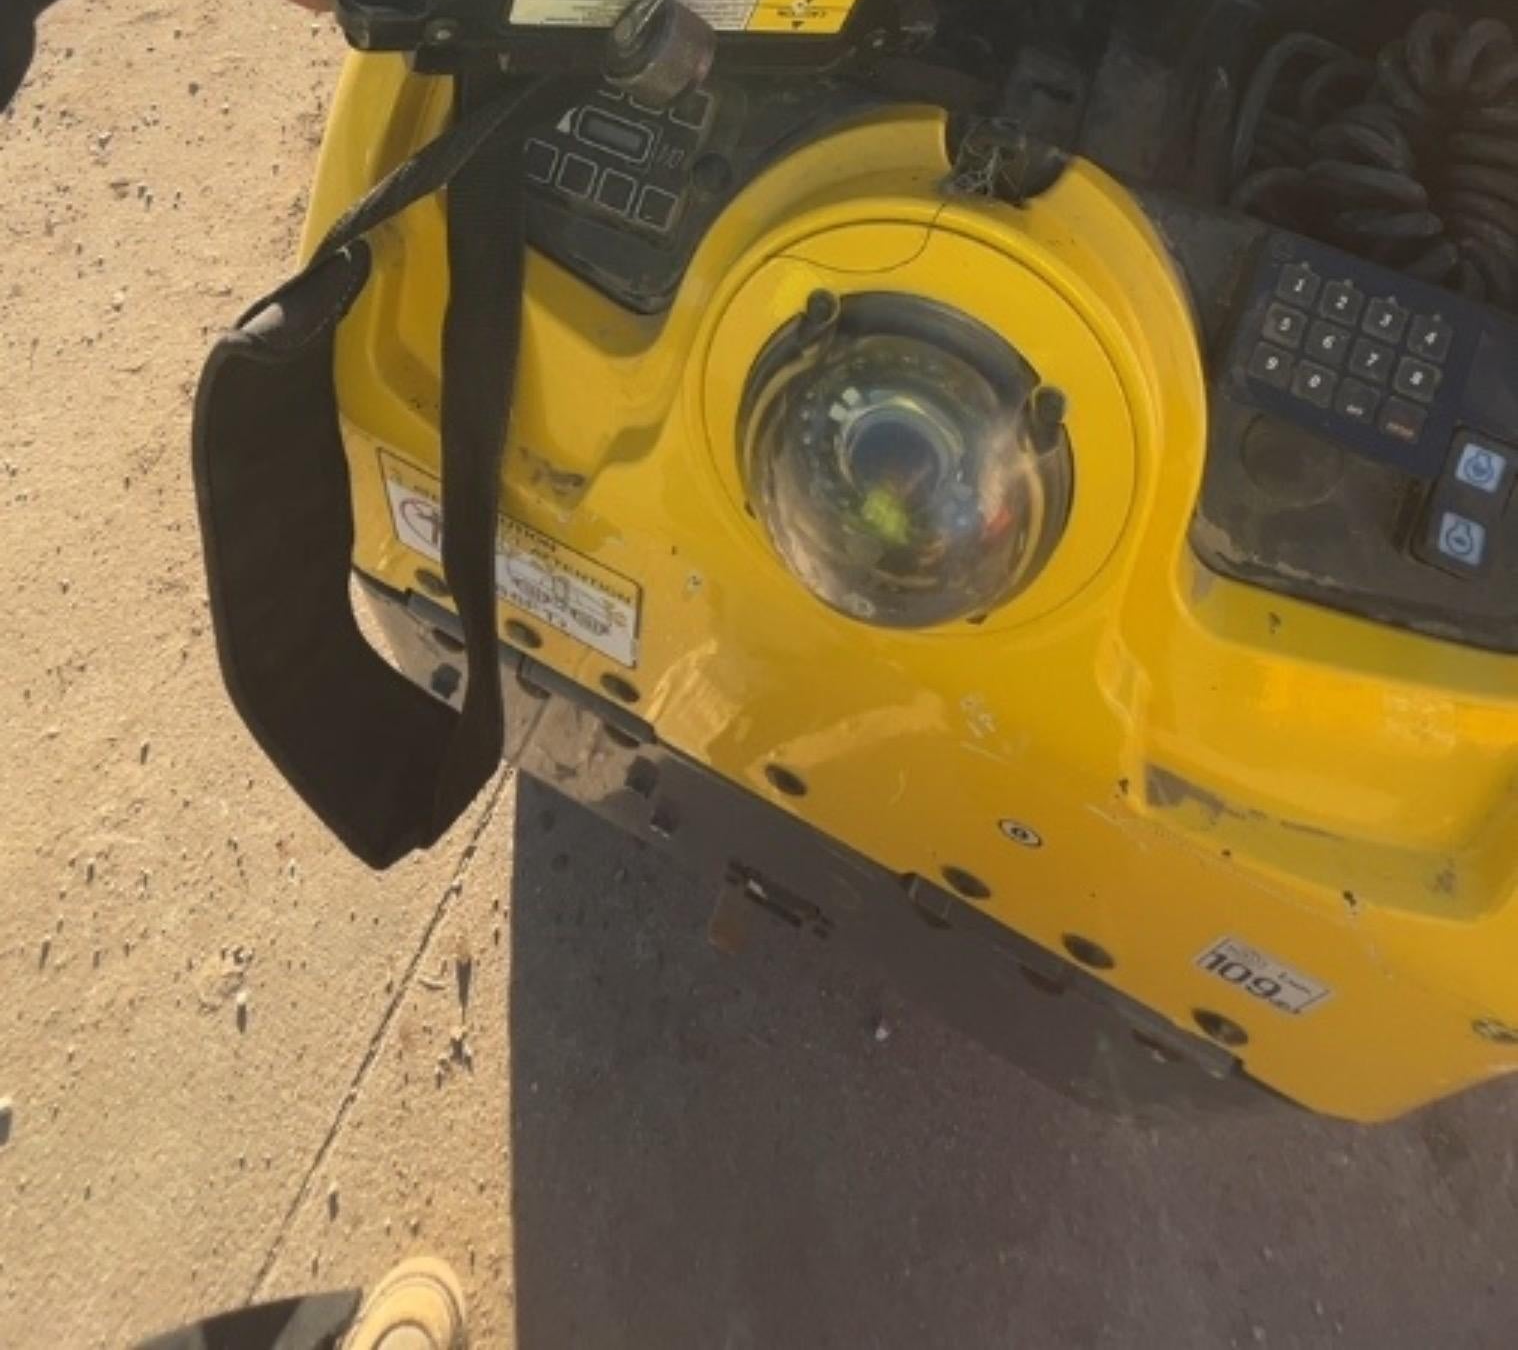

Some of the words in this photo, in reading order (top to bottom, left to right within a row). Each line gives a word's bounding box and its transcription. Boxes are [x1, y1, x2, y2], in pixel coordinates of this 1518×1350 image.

[1295, 278, 1305, 292] 1
[1335, 295, 1348, 310] 2
[1379, 313, 1393, 327] 3
[1424, 331, 1437, 345] 4
[1205, 953, 1281, 999] 109
